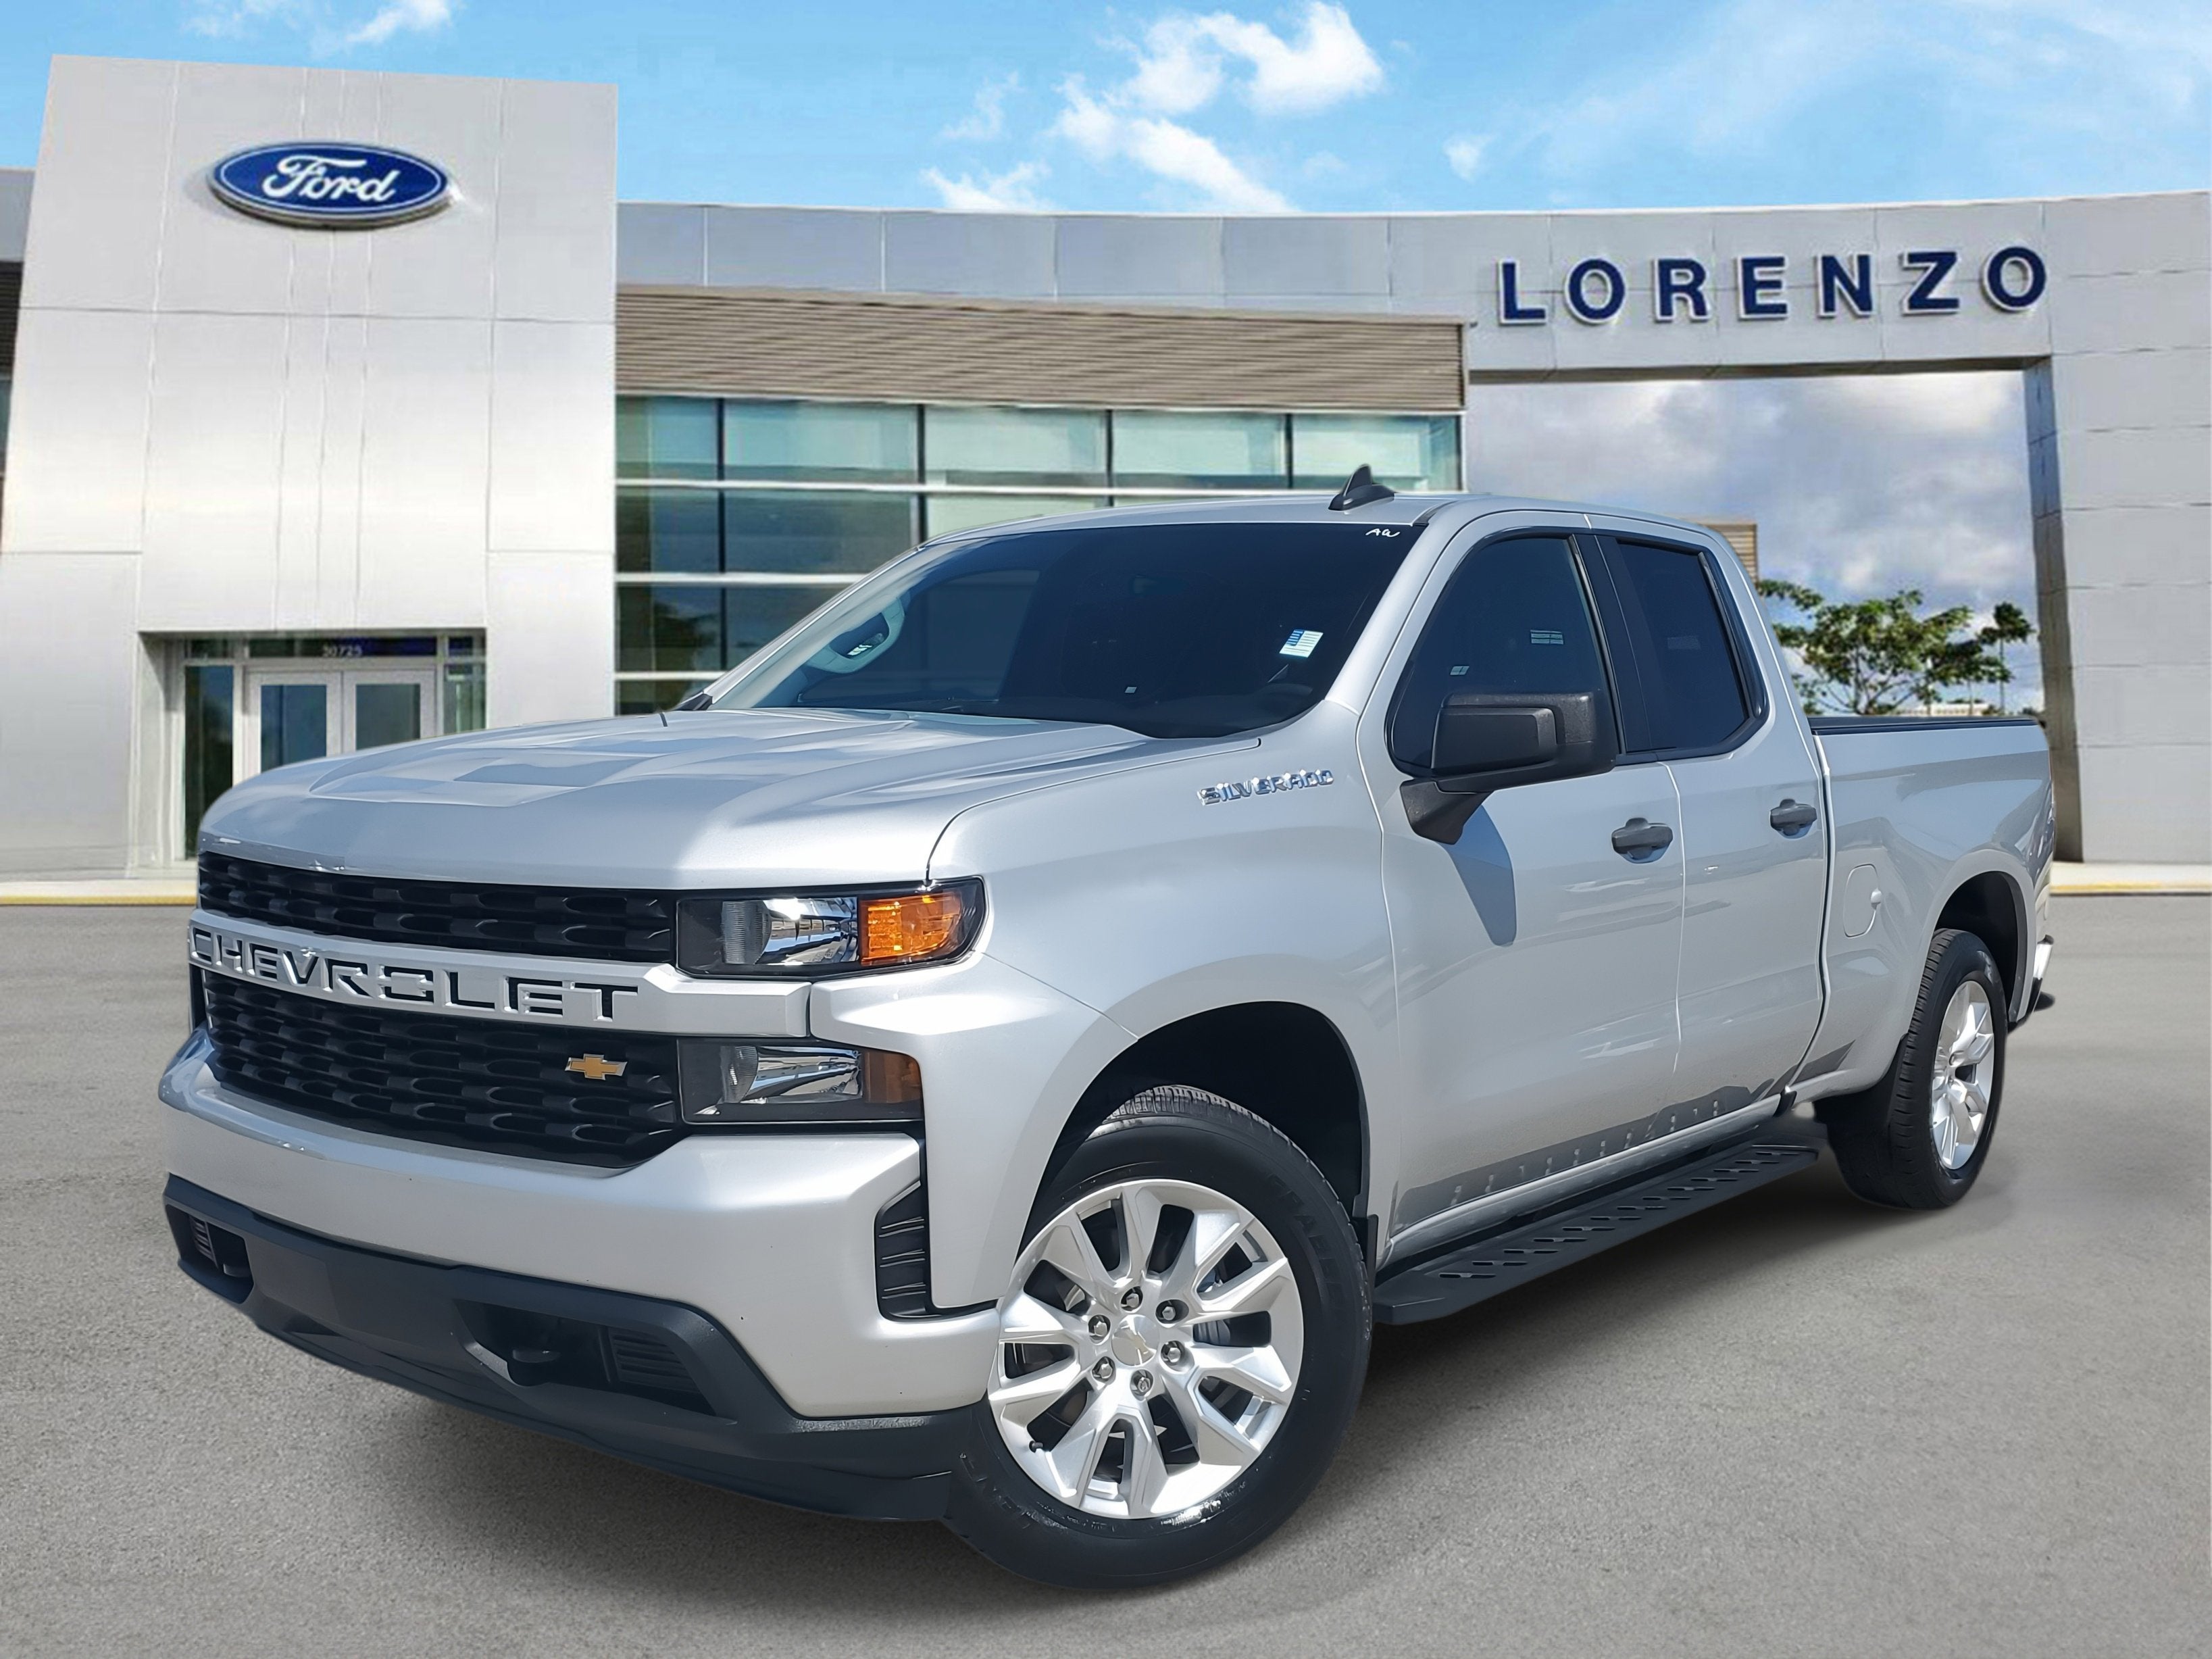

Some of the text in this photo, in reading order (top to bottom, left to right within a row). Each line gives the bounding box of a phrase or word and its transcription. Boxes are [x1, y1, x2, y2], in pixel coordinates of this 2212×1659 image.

[262, 154, 400, 202] Ford
[1499, 246, 2047, 323] LORENZO
[1197, 770, 1334, 806] SILVERADO
[191, 926, 639, 1022] CHEVROLET
